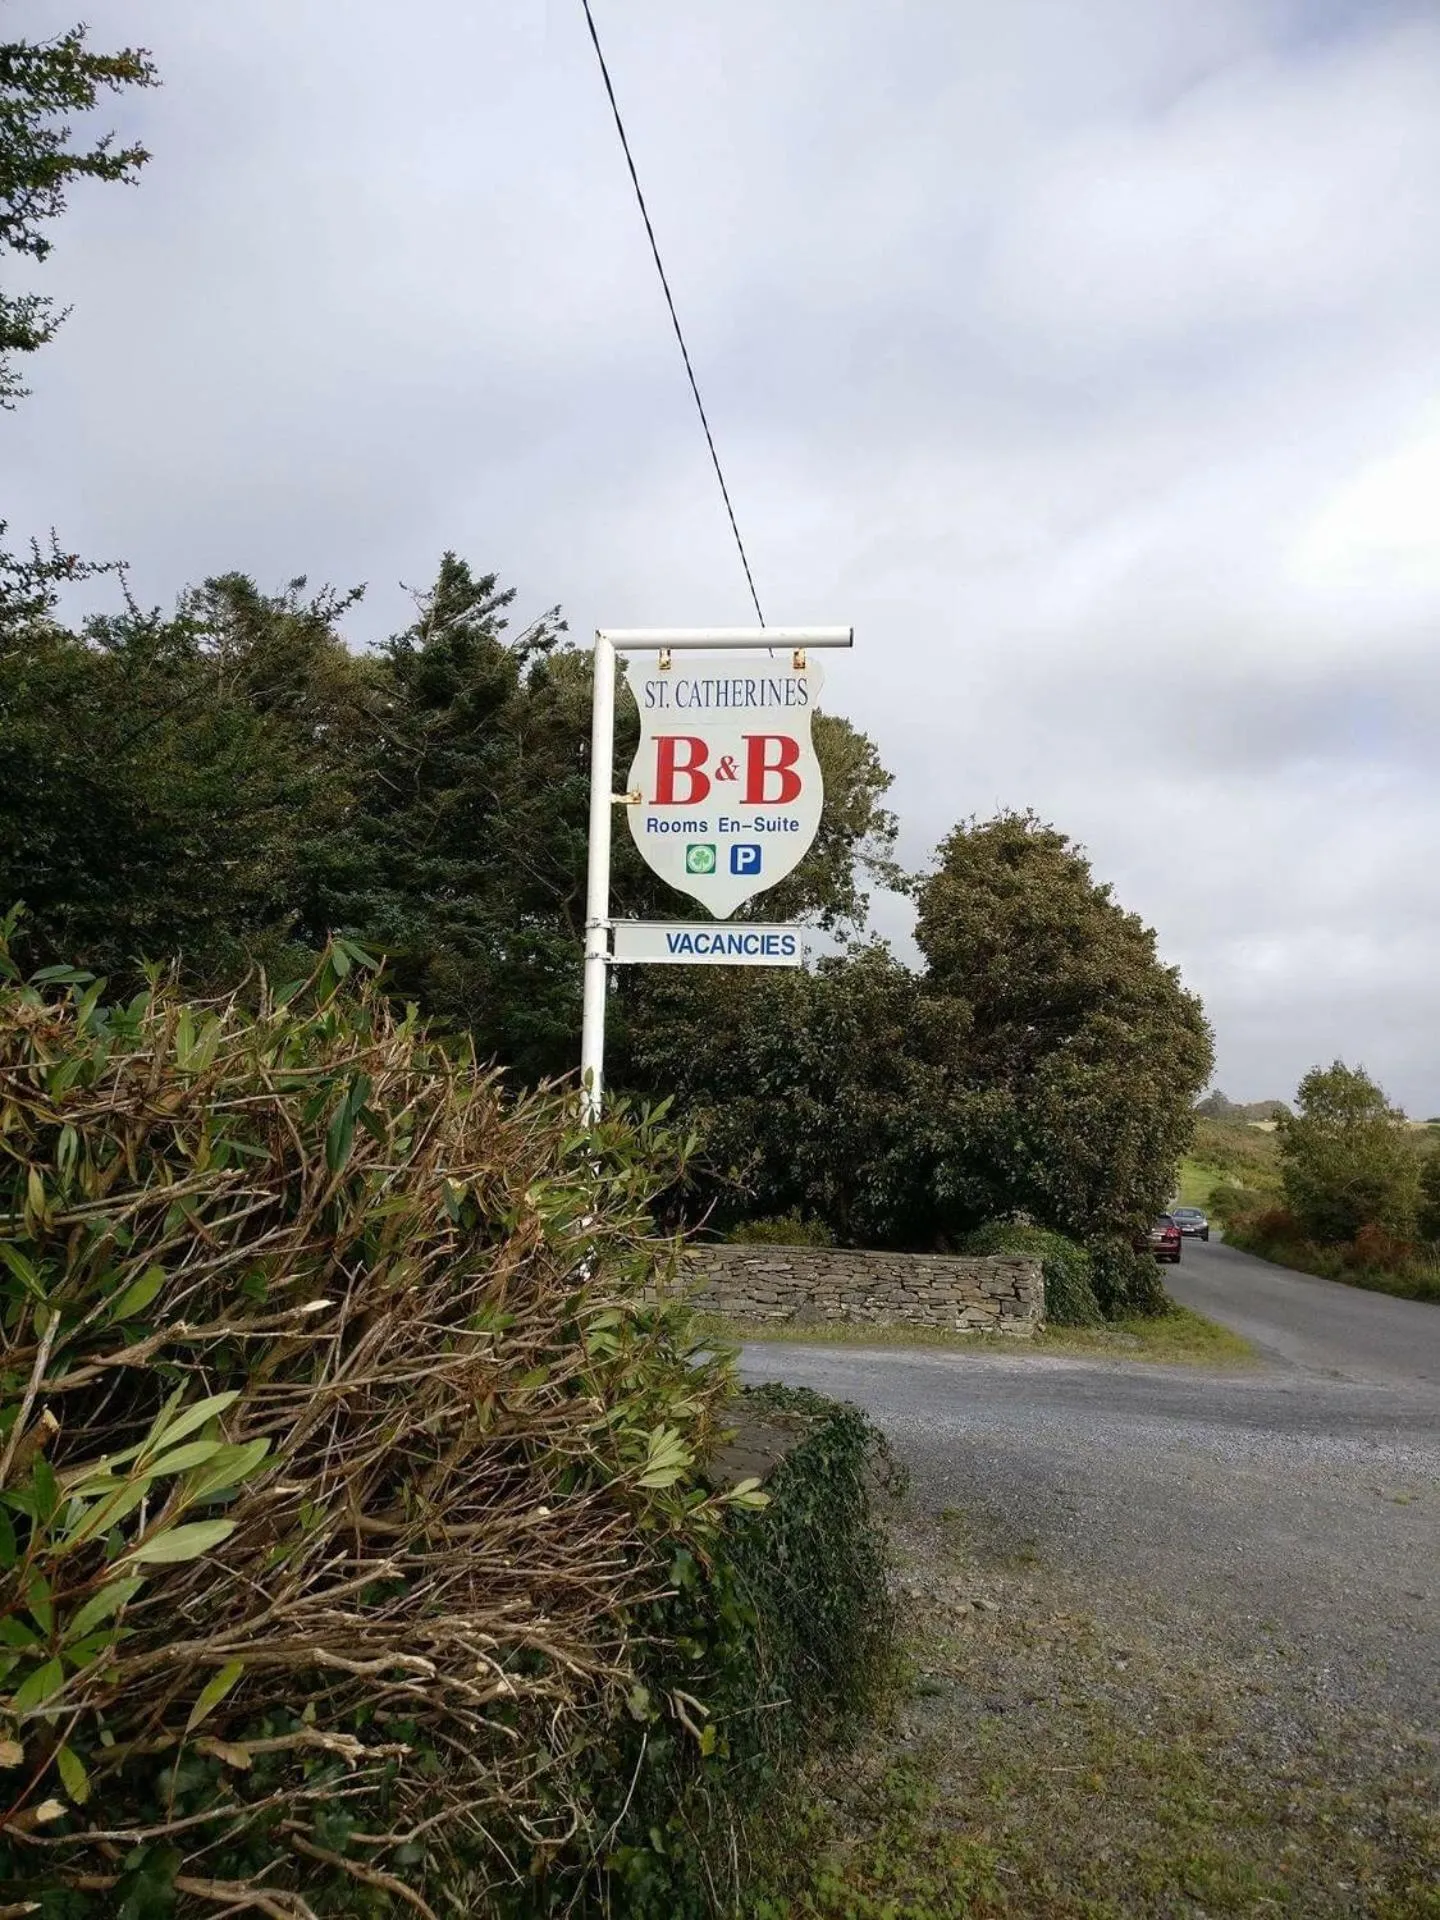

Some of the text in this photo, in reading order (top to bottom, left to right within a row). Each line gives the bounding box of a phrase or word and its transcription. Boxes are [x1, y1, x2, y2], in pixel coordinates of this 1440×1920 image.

[644, 677, 809, 708] ST. CATHERINES
[648, 735, 803, 805] B&B
[646, 816, 800, 833] Rooms En-Suite
[736, 847, 756, 872] P
[666, 933, 796, 956] VACANCIES
